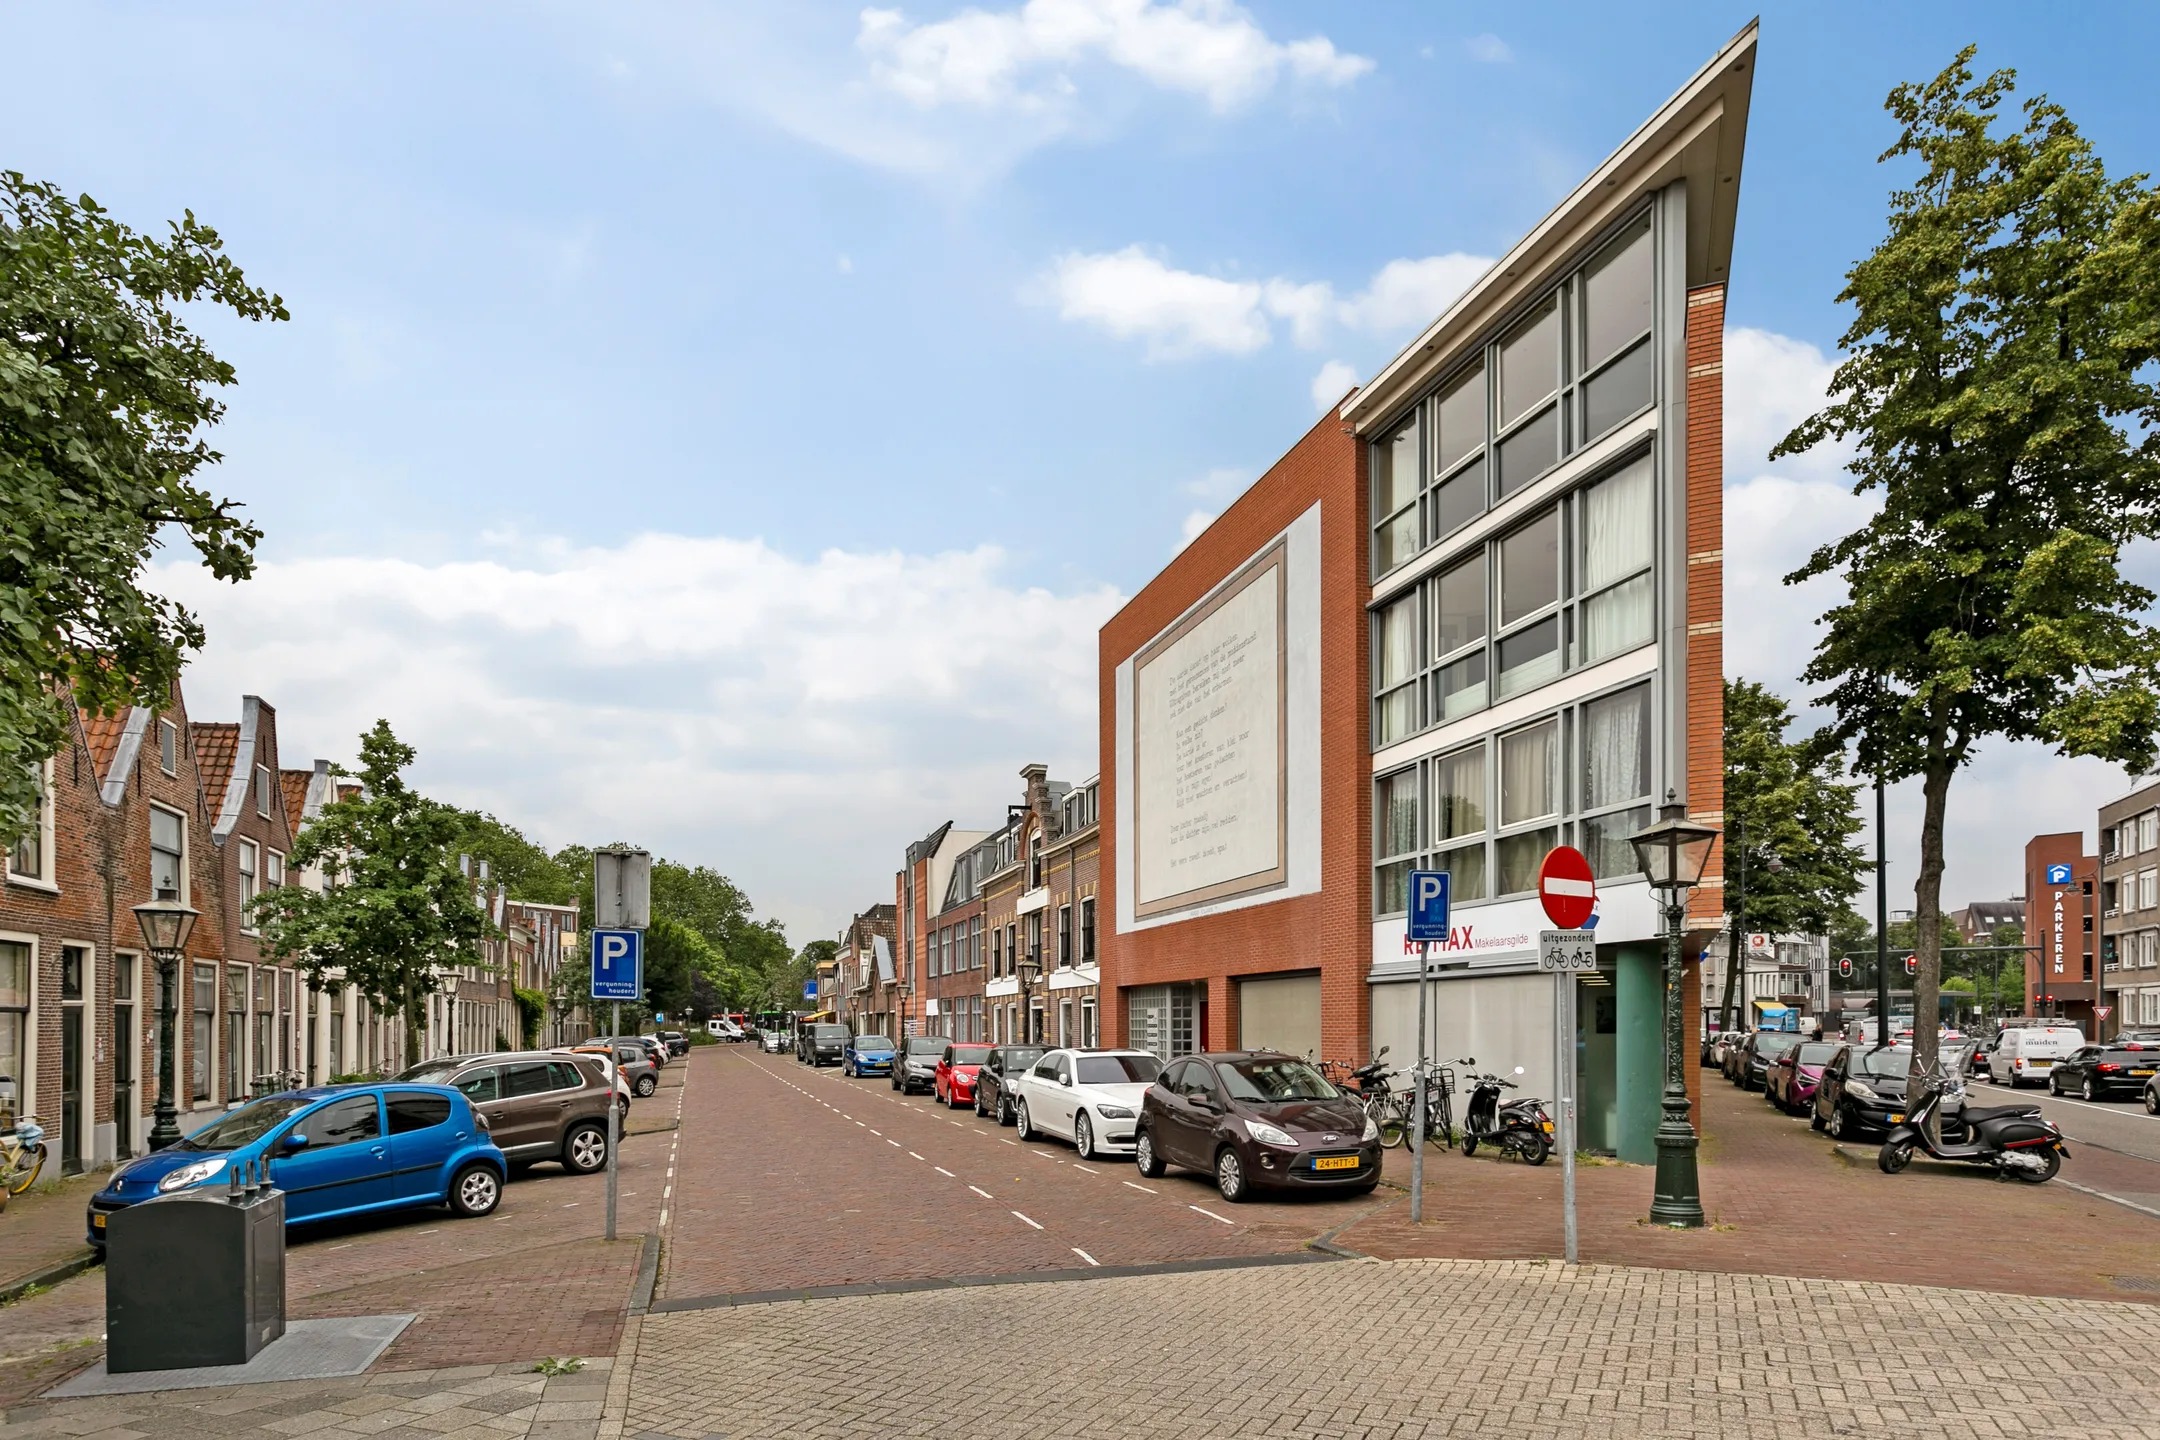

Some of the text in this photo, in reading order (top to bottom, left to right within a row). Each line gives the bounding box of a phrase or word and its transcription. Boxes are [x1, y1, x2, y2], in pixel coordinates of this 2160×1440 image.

[1543, 933, 1593, 944] uitgezonderd
[2054, 891, 2064, 973] PARKEREN
[1475, 934, 1529, 948] Makelaarsgilde
